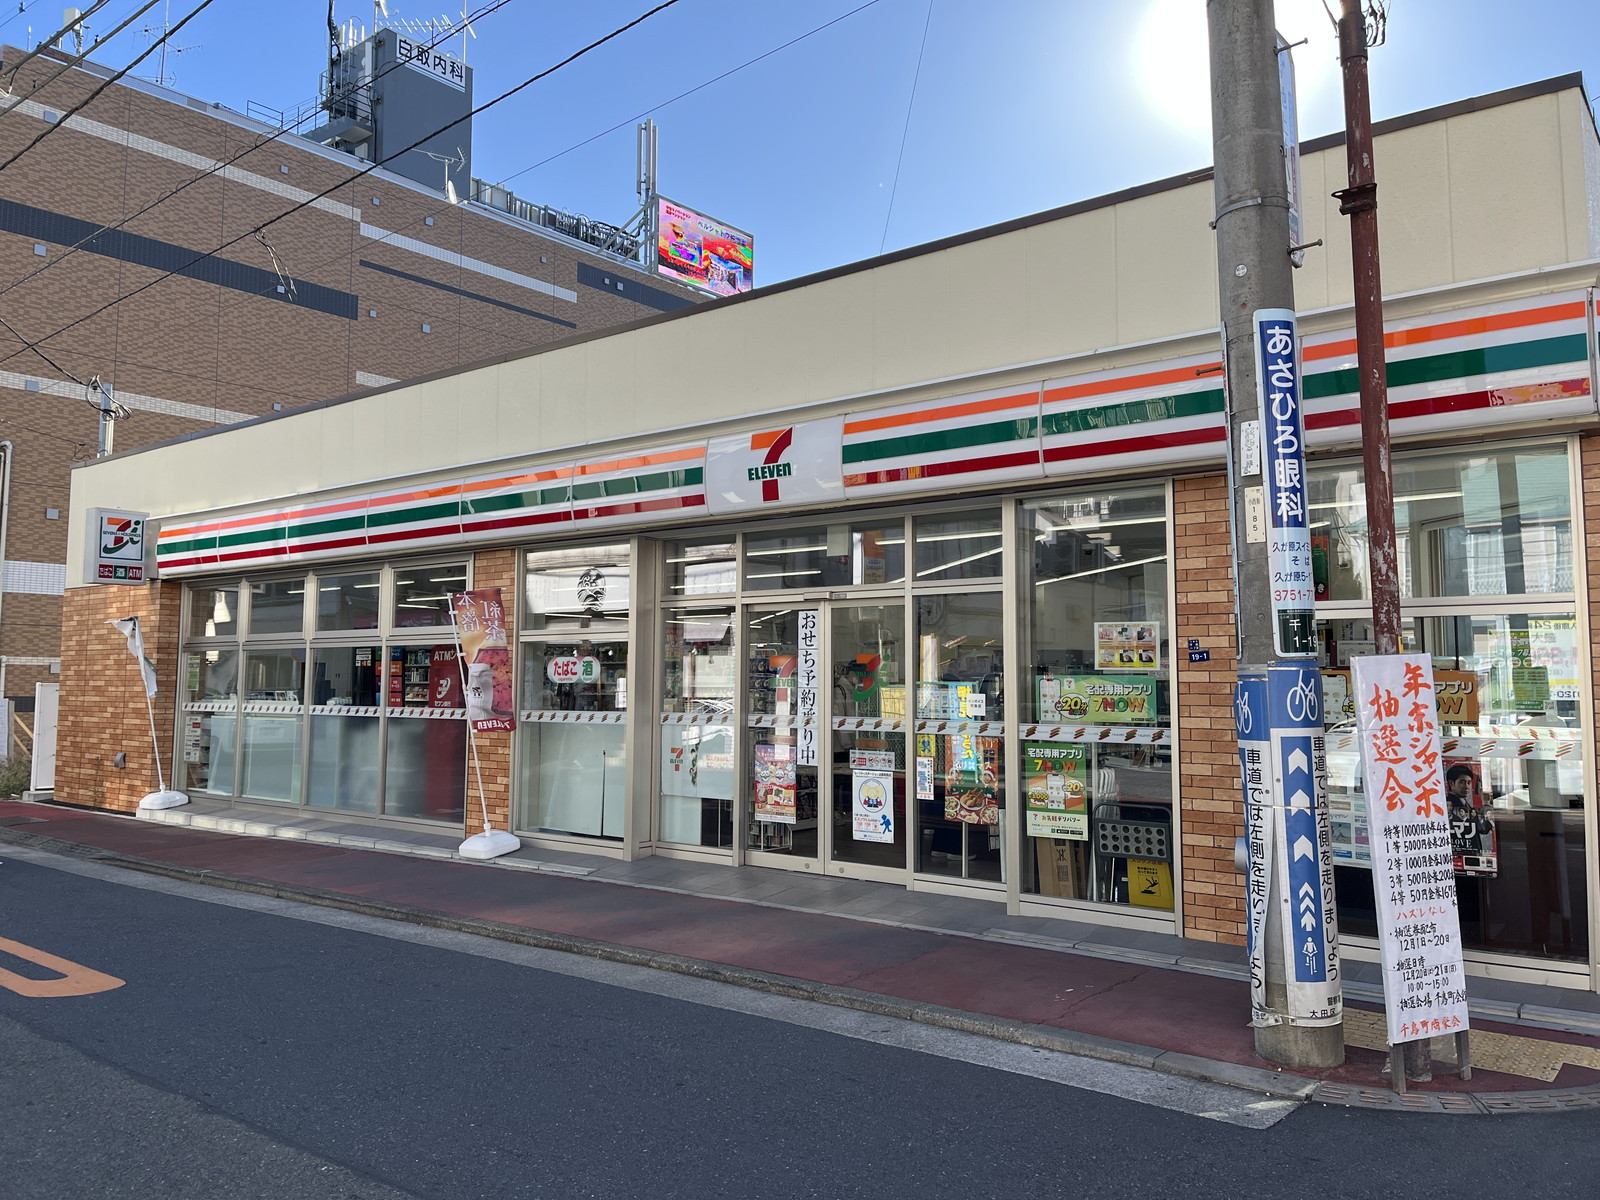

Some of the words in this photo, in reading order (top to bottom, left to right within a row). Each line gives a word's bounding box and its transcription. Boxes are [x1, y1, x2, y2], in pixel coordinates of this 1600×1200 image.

[398, 39, 464, 83] 白取内科
[1267, 326, 1302, 522] あさひろ眼科
[116, 568, 125, 577] 酒
[128, 569, 142, 578] ATM
[434, 651, 450, 661] ATM
[553, 661, 578, 676] たばこ
[582, 660, 593, 676] 酒
[1085, 684, 1152, 696] 宅配専用アプリ
[1093, 697, 1145, 713] 7NOW
[1027, 747, 1082, 759] 宅配専用アプリ
[1369, 683, 1413, 812] 抽選会
[1034, 760, 1077, 773] 7NOW
[1396, 906, 1446, 920] ハズレなし
[1309, 1007, 1336, 1018] 大田区
